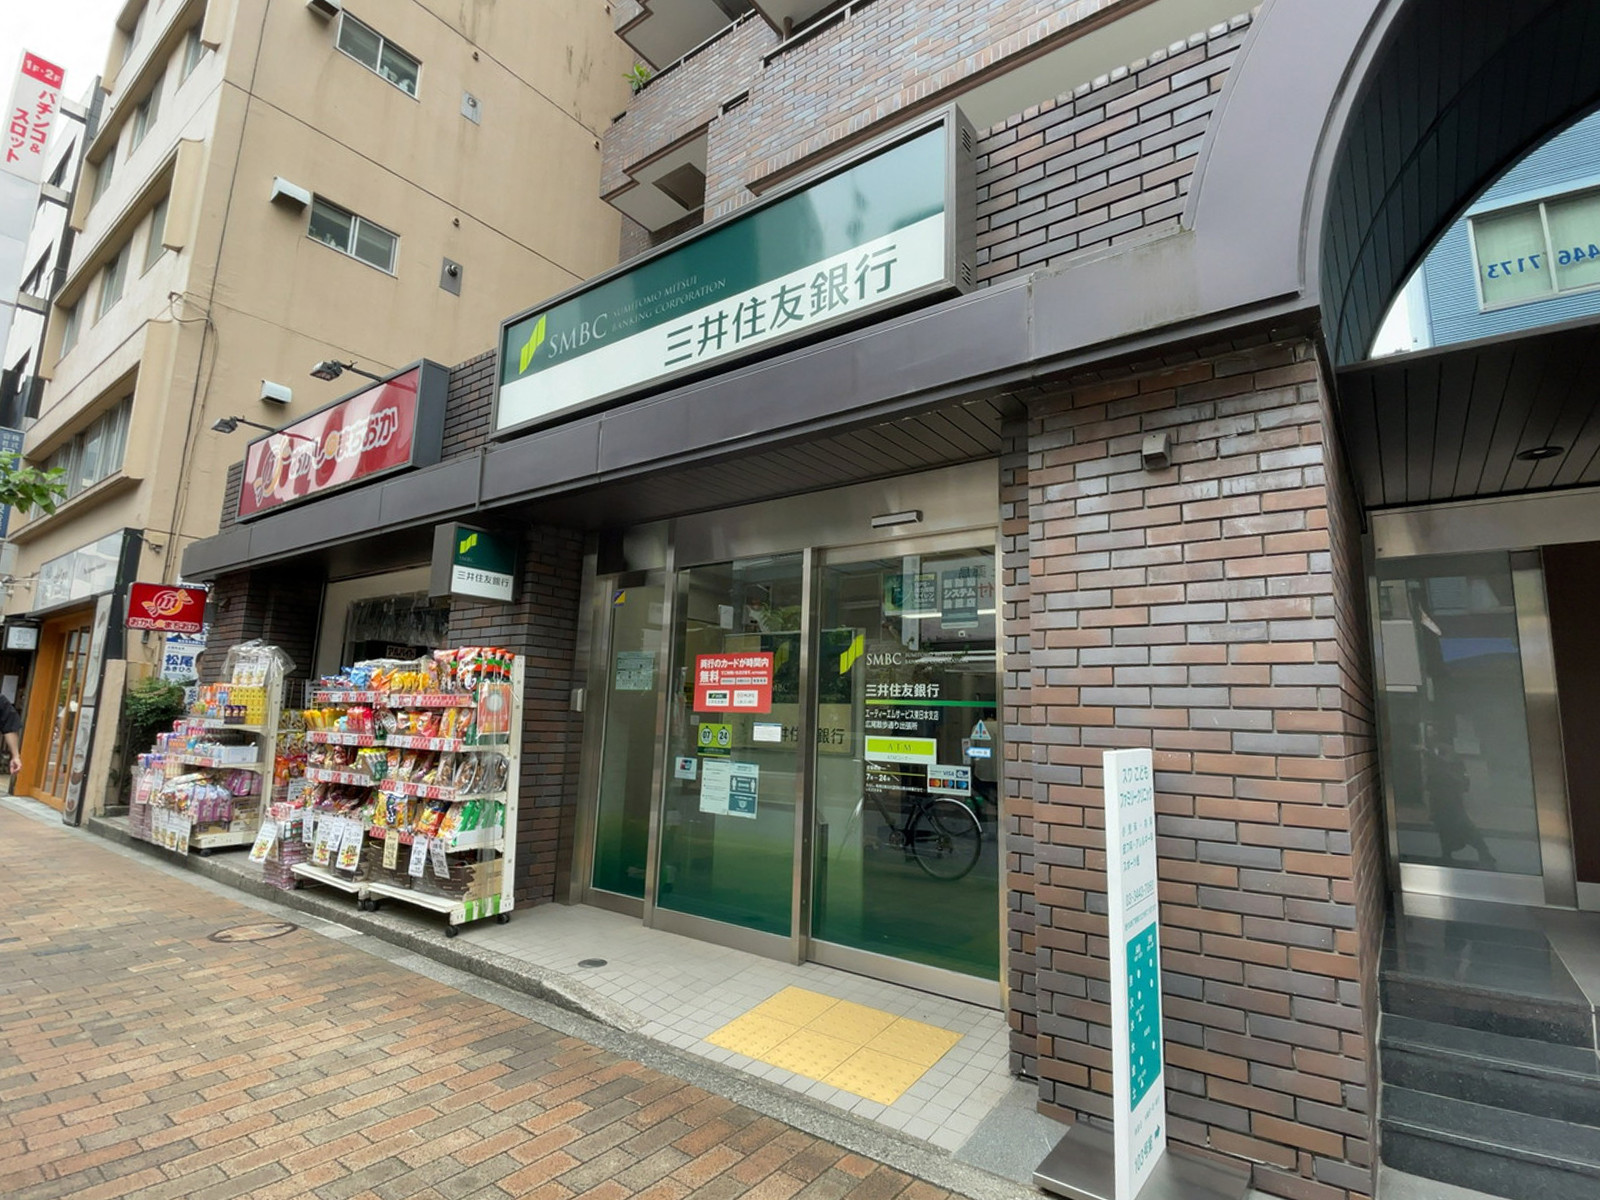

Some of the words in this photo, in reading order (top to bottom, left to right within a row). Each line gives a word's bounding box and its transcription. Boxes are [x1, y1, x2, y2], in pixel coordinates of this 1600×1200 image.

[6, 107, 30, 163] スロット
[611, 309, 653, 333] BANKING
[655, 277, 728, 314] CORPORATION
[612, 289, 662, 318] SUMITOMO
[664, 274, 699, 296] MITSUI
[664, 244, 898, 367] 三井住友銀行
[548, 313, 608, 359] SMBC
[456, 570, 509, 588] 三井住友銀行
[165, 654, 193, 667] 松尾
[866, 653, 902, 666] SMBC
[866, 684, 940, 698] 三井住友銀行
[702, 731, 711, 739] 07
[719, 731, 728, 740] 24
[888, 743, 912, 752] ATM
